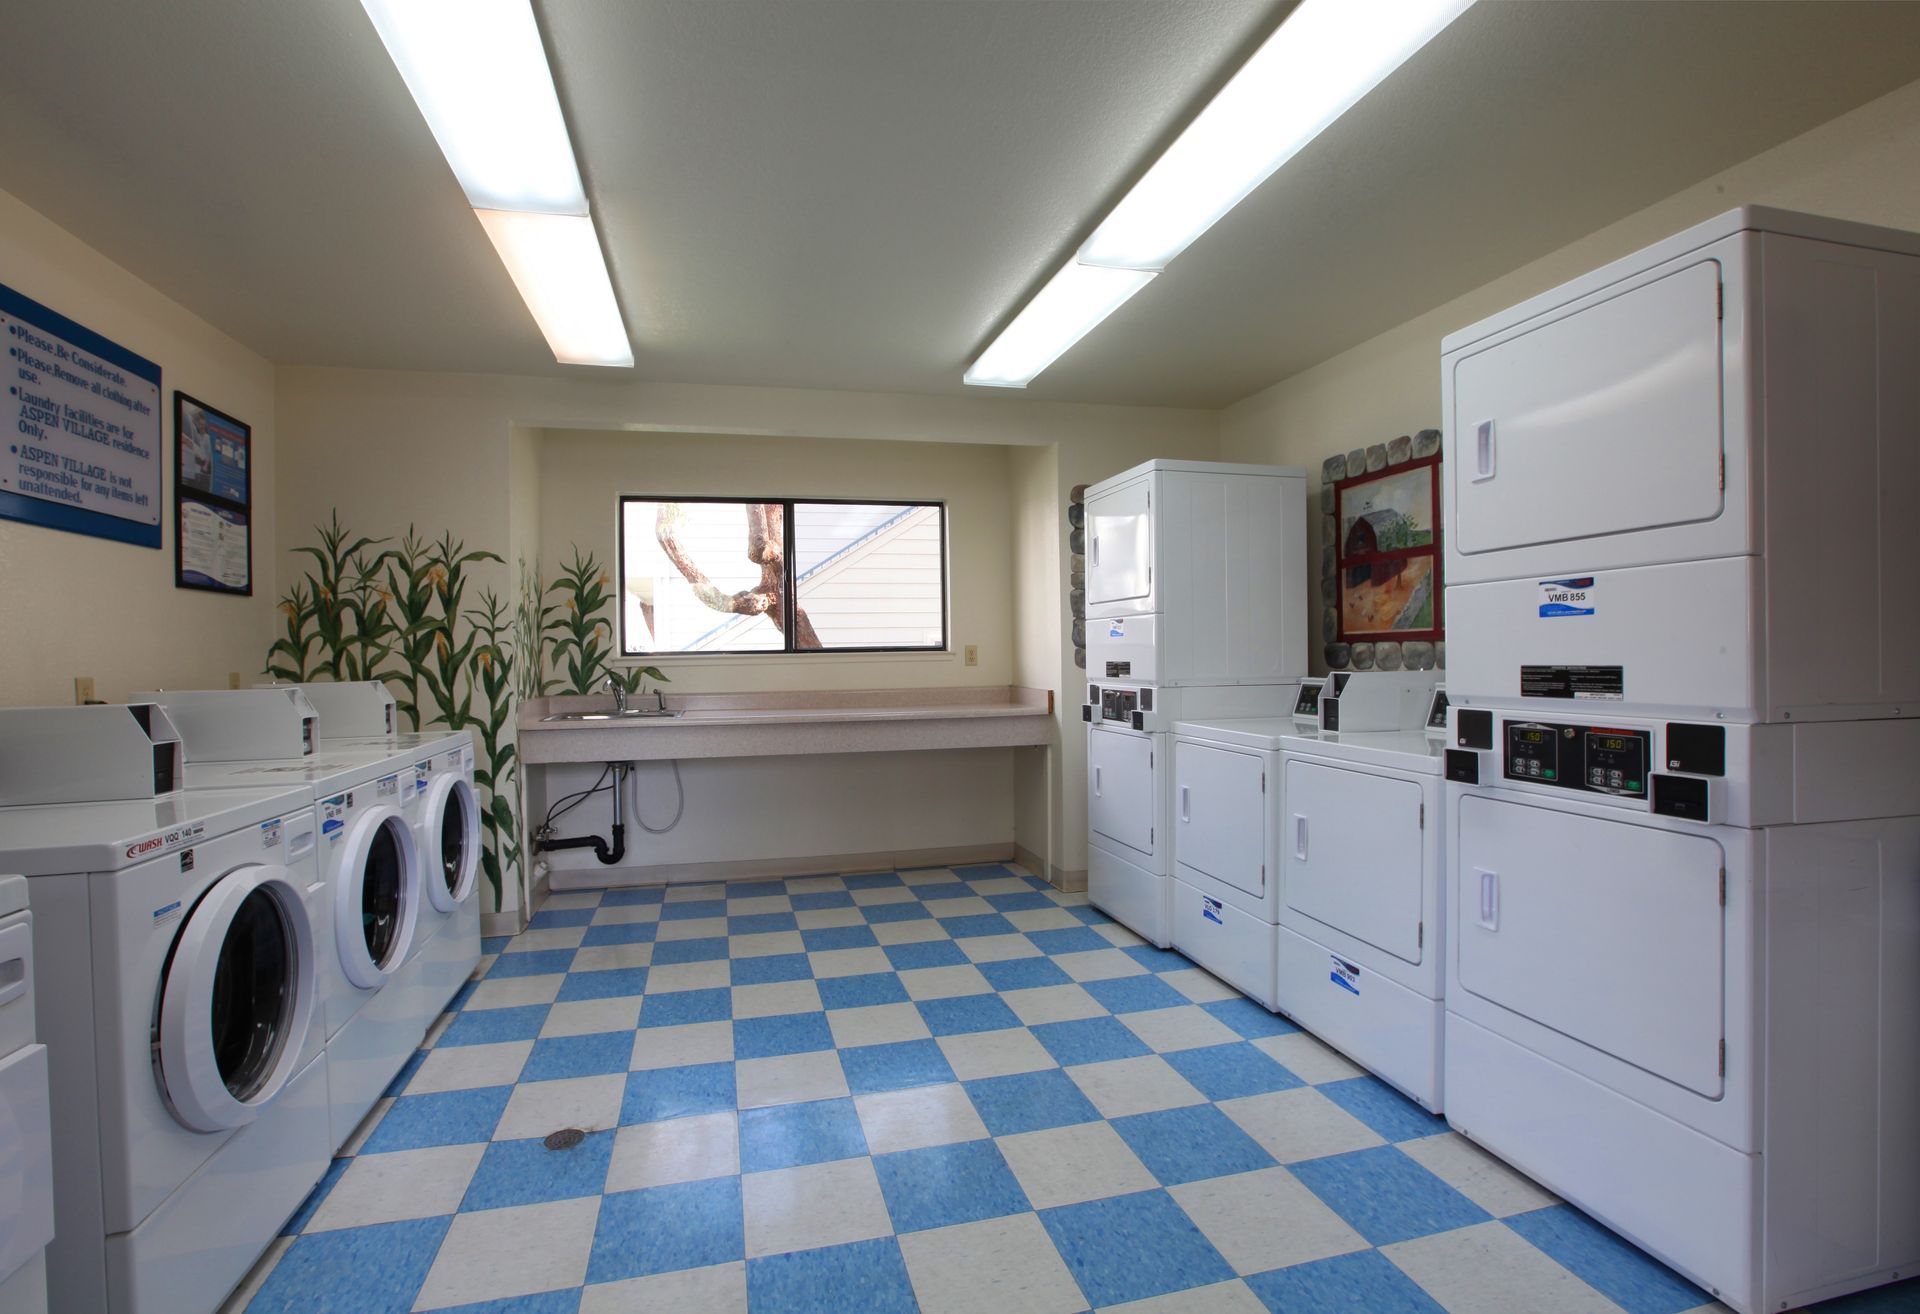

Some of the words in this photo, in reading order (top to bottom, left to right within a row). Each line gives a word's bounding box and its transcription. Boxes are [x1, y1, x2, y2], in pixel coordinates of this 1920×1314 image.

[18, 367, 41, 385] use.
[71, 351, 127, 388] Considerate.
[18, 387, 60, 416] Laundry
[64, 404, 104, 430] facilities
[106, 422, 120, 434] are
[122, 425, 134, 440] for
[91, 382, 102, 396] all
[102, 386, 132, 411] clothing
[133, 400, 151, 416] after
[18, 420, 48, 441] Only.
[19, 405, 59, 428] ASPEN
[62, 417, 110, 446] VILLAGE
[112, 438, 150, 459] residence
[20, 445, 59, 467] ASPEN
[61, 456, 107, 481] VILLAGE
[110, 471, 117, 484] is
[118, 477, 132, 489] not
[18, 464, 79, 488] responsible
[81, 477, 93, 492] for
[94, 483, 110, 499] any
[111, 486, 134, 503] items
[135, 492, 149, 507] left
[18, 479, 83, 504] unattended.
[1549, 593, 1569, 602] VMB
[1570, 592, 1586, 601] 855
[1606, 739, 1622, 749] 150
[182, 826, 192, 838] 140
